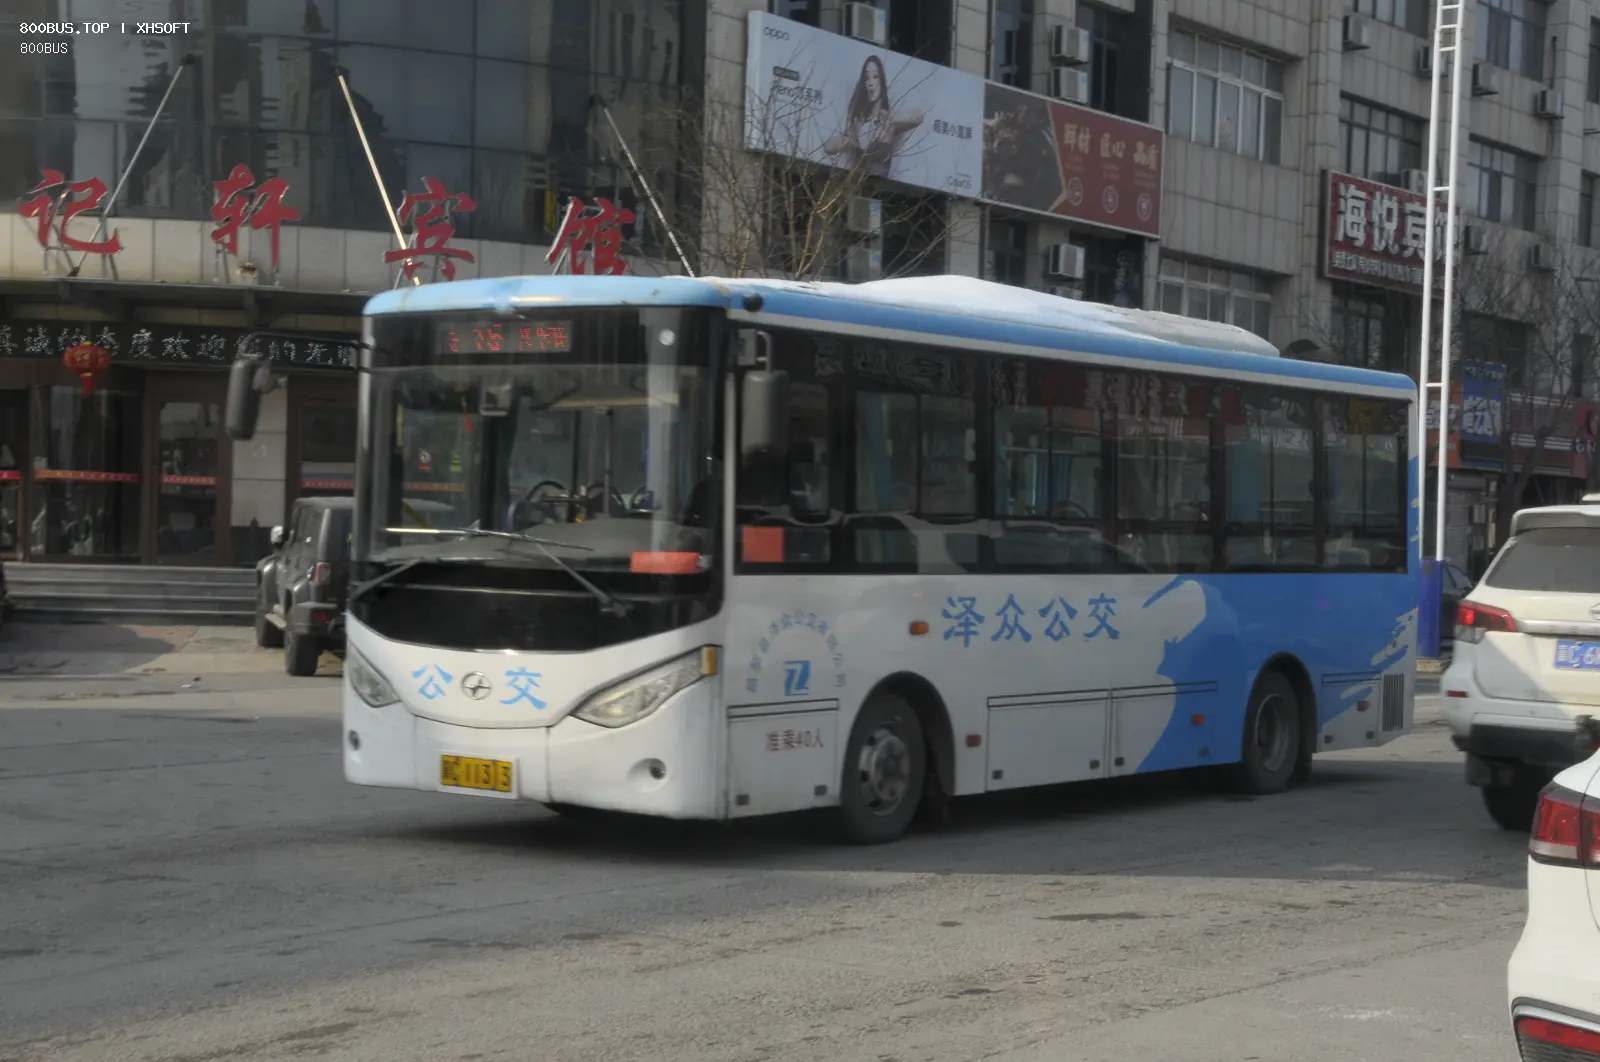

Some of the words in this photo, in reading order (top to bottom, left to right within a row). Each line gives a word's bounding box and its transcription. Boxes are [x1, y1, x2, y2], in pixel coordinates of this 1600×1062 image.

[941, 593, 1121, 647] 泽众公交
[412, 662, 454, 700] 公
[501, 667, 546, 709] 交
